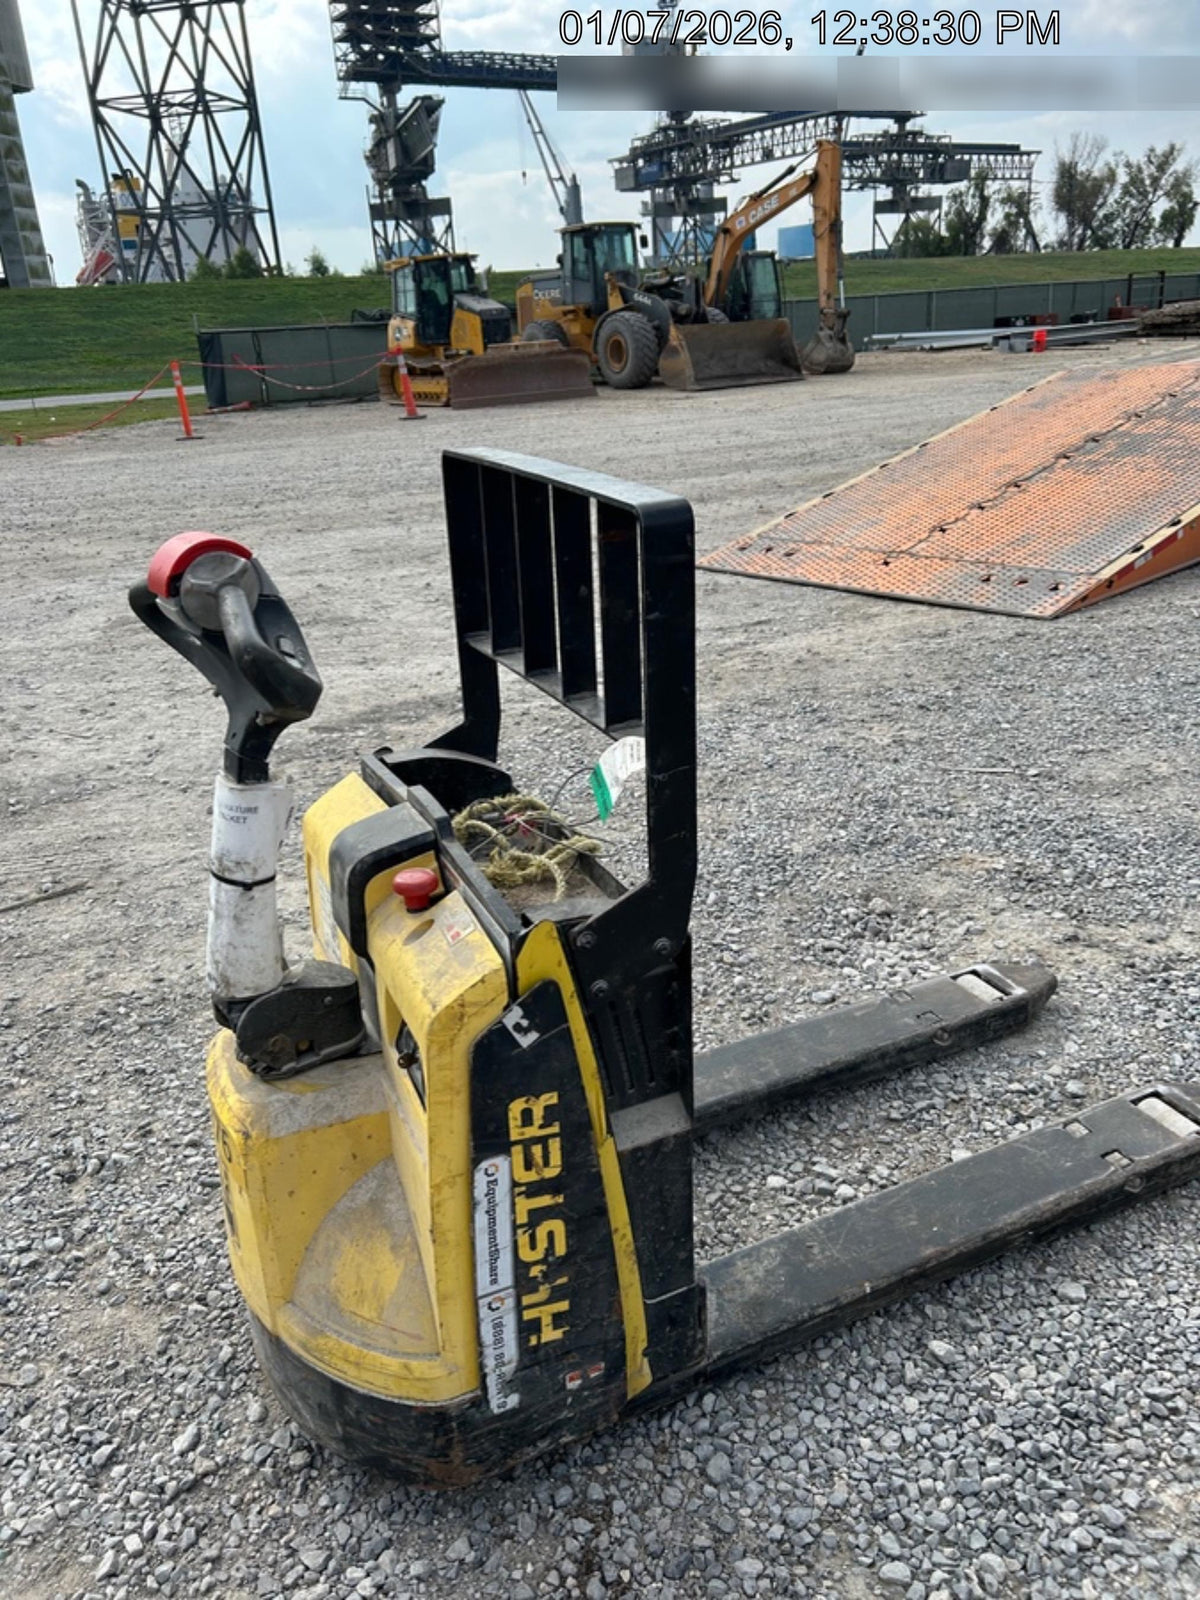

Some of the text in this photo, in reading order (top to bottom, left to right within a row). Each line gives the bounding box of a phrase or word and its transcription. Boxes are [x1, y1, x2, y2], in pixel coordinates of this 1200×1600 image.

[748, 194, 780, 225] CASE
[533, 288, 562, 300] DEERE
[483, 1178, 500, 1287] EquipmentShare
